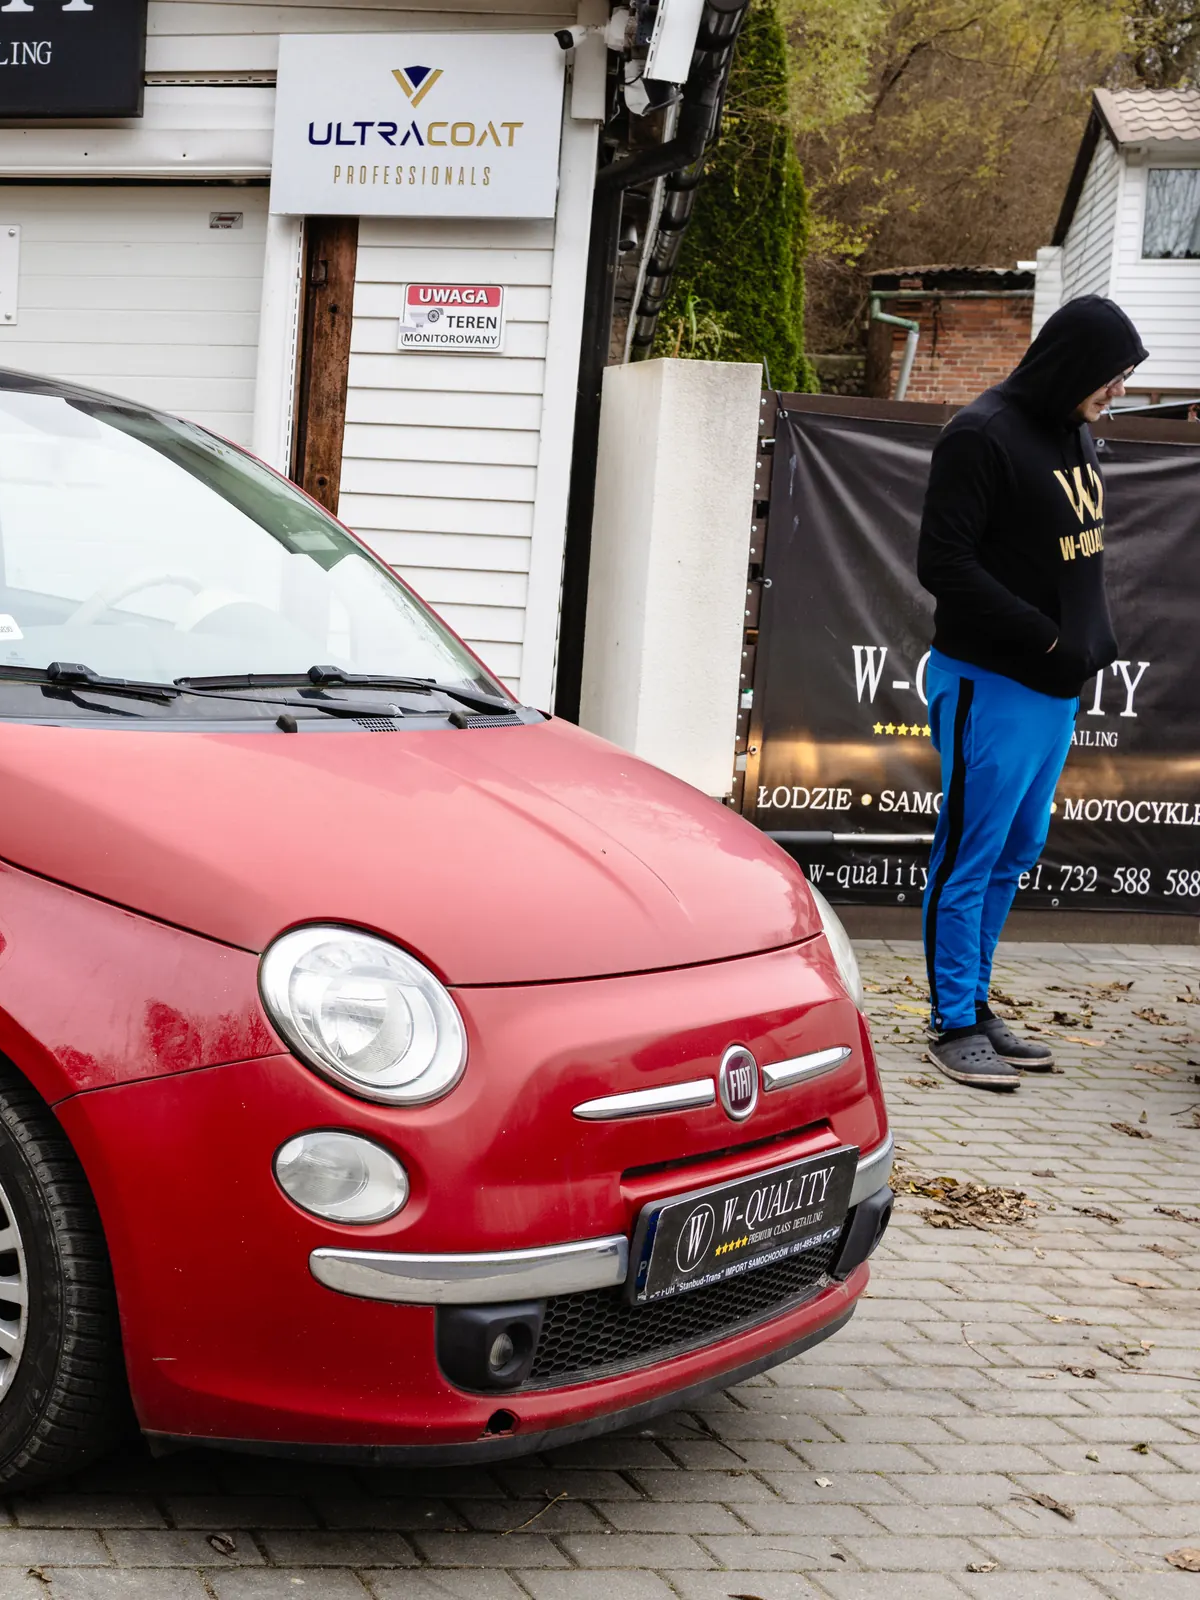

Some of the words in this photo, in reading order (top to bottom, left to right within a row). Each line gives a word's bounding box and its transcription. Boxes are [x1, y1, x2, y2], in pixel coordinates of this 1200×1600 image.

[308, 120, 524, 147] ULTRACOAT
[333, 165, 491, 186] PROFESSIONALS
[418, 287, 489, 305] UWAGA
[446, 315, 497, 329] TEREN
[403, 332, 497, 345] MONITOROWANY
[1070, 730, 1118, 748] AILING
[757, 785, 852, 811] ŁODZIE
[1018, 864, 1098, 893] el.732
[1111, 866, 1151, 894] 588
[1163, 868, 1200, 897] 588
[729, 1065, 751, 1102] FIAT
[721, 1166, 835, 1236] W-QUALITY
[687, 1211, 710, 1262] W
[747, 1227, 773, 1245] PREMIUM
[773, 1220, 792, 1236] CLASS
[792, 1211, 824, 1230] DETAILING
[724, 1261, 748, 1277] IMPORT
